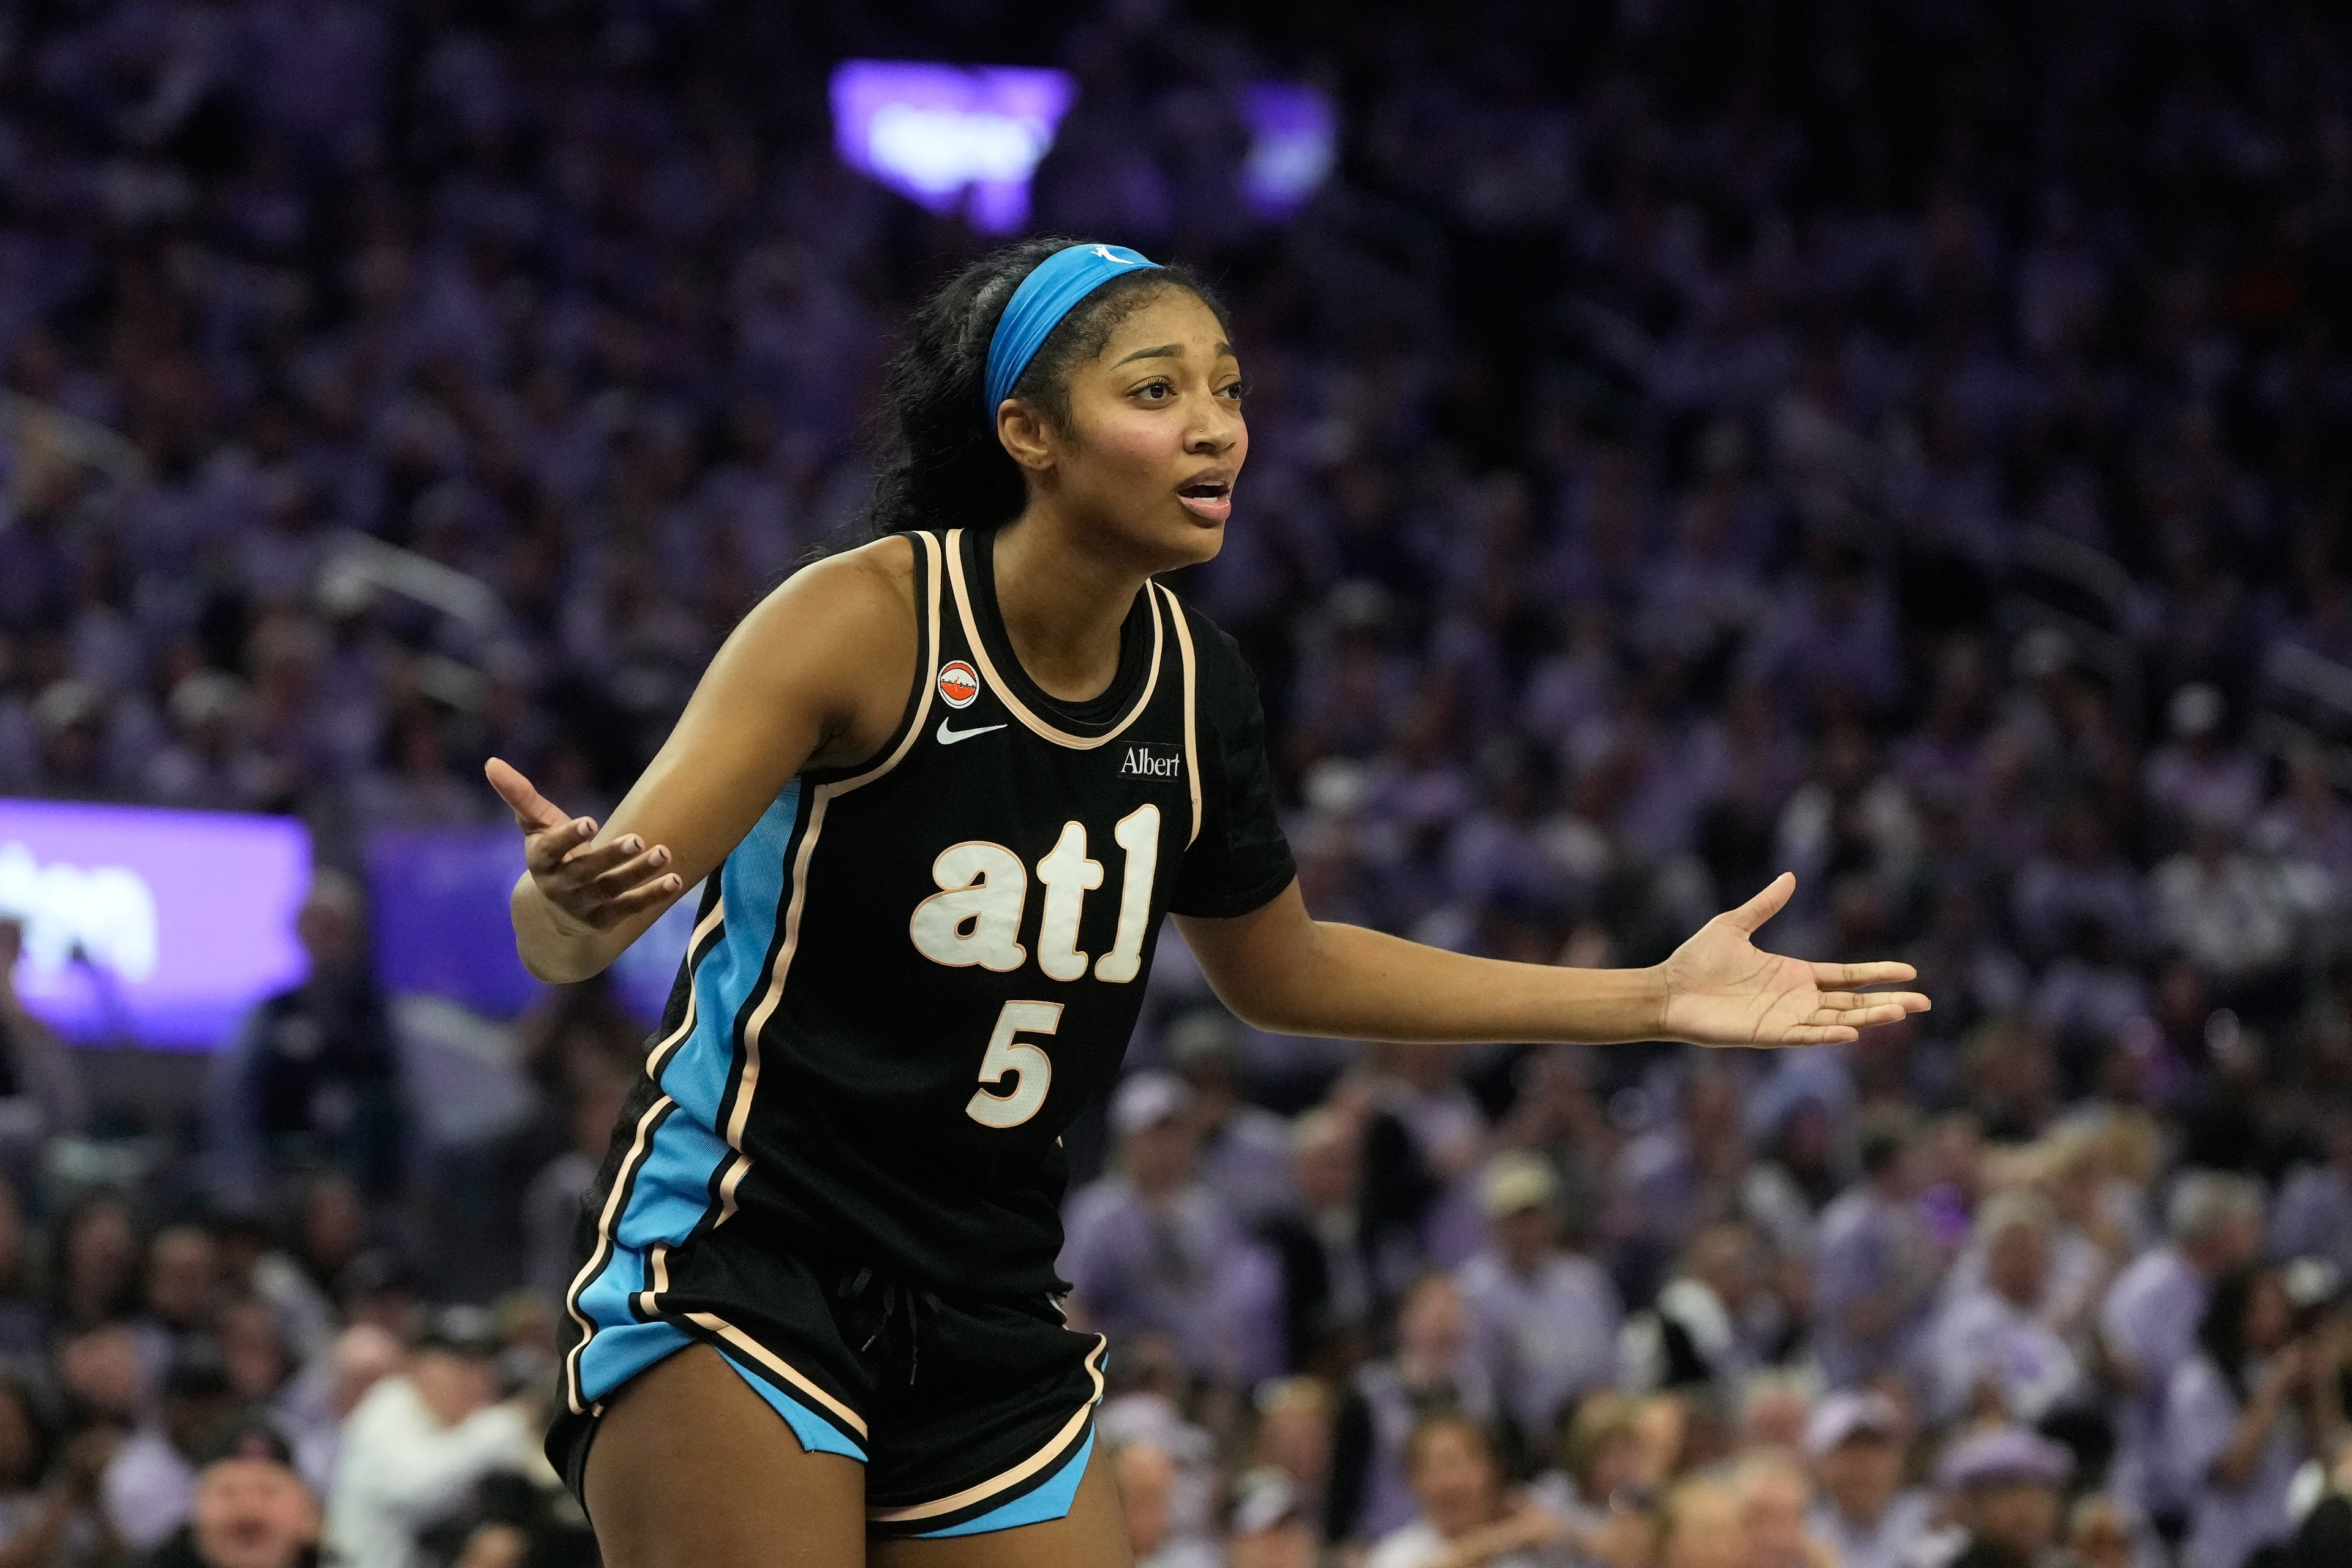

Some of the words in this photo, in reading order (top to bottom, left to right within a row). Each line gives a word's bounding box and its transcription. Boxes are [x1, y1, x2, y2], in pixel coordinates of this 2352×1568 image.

[1120, 747, 1180, 777] Albert
[910, 804, 1160, 983] atl
[966, 1000, 1065, 1128] 5
